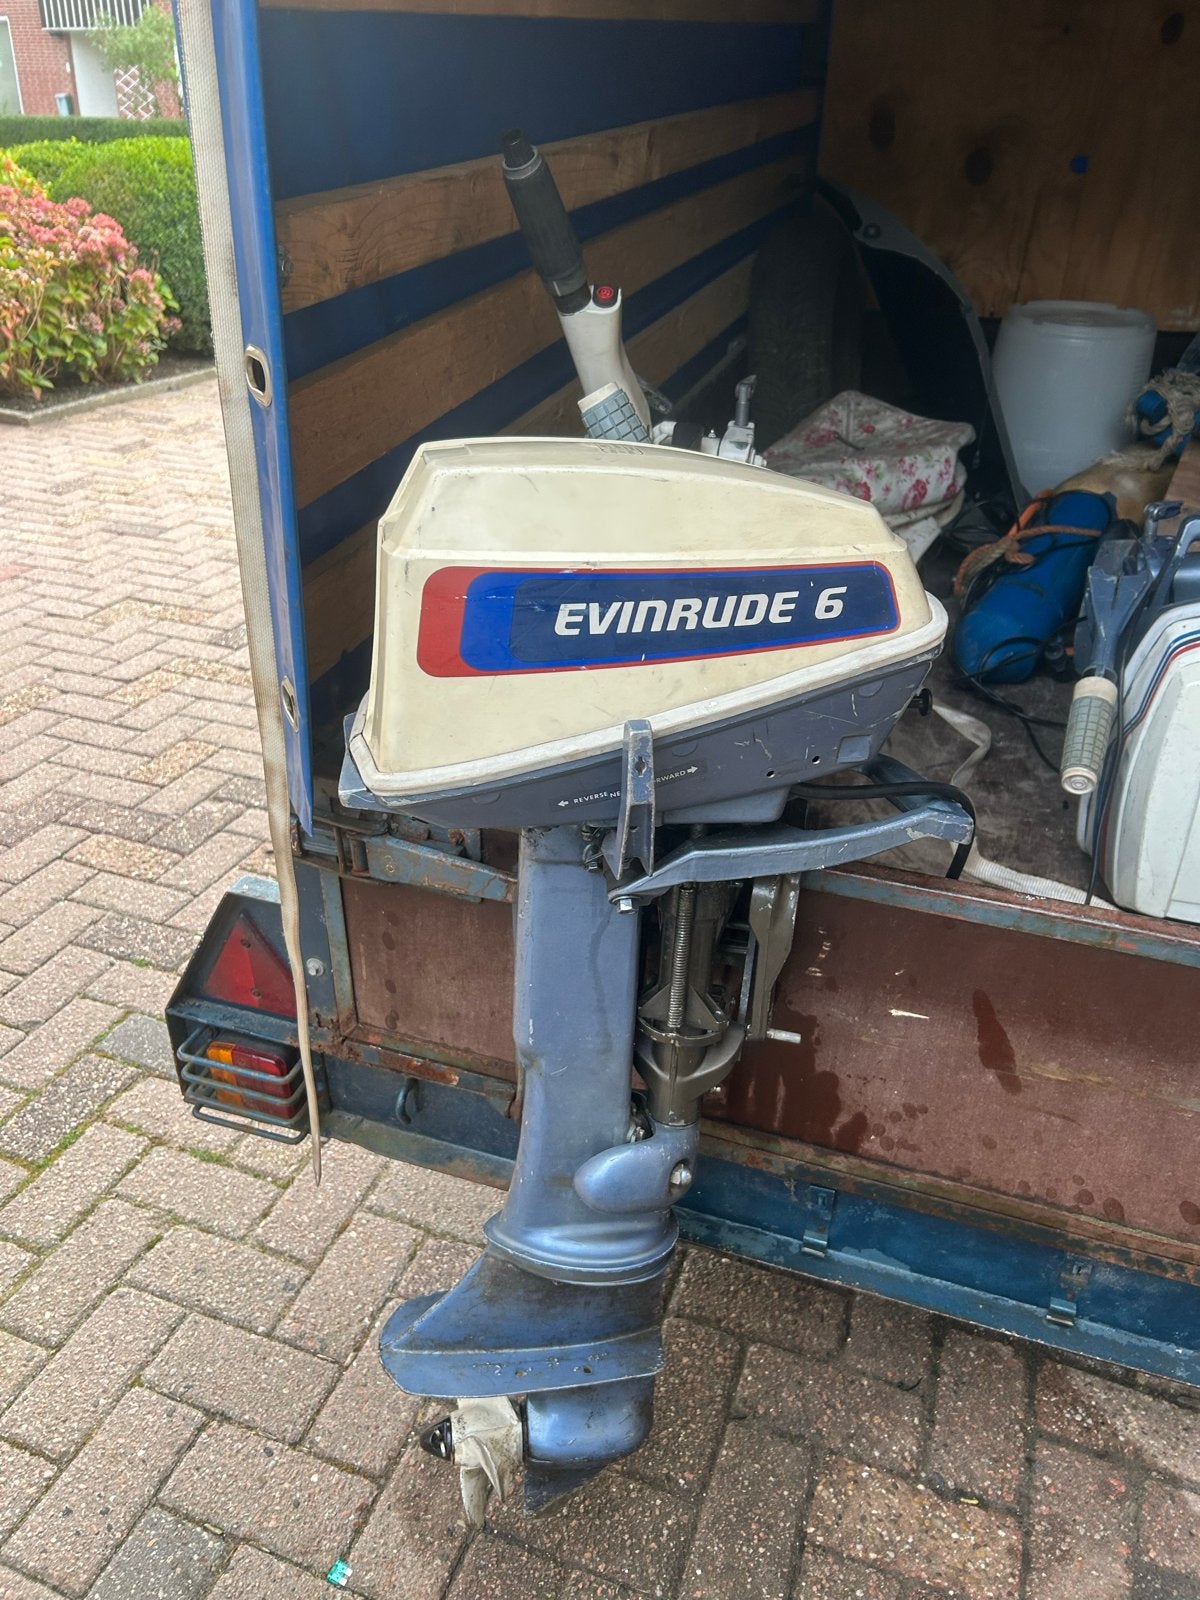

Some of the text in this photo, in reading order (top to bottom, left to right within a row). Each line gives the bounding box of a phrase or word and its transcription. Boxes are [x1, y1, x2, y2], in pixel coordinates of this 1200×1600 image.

[554, 586, 847, 636] EVINRUDE 6
[573, 791, 608, 804] REVERSE
